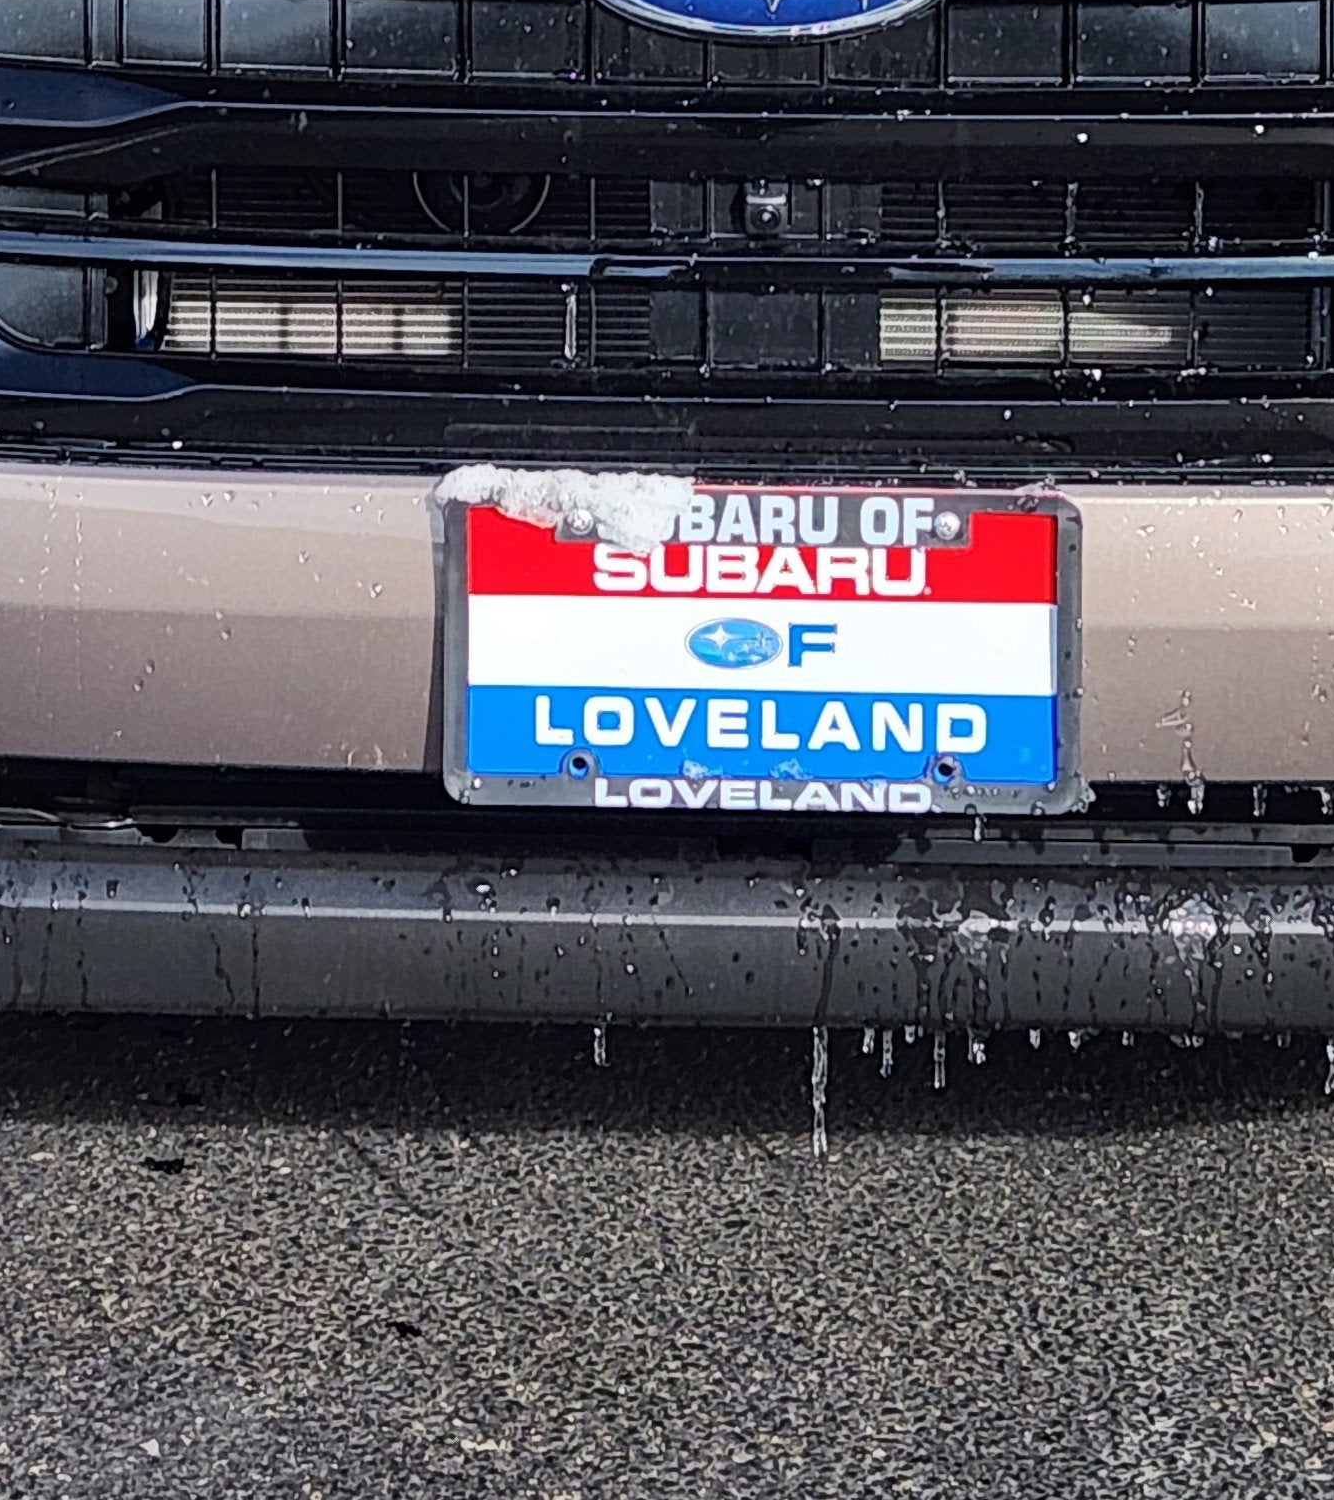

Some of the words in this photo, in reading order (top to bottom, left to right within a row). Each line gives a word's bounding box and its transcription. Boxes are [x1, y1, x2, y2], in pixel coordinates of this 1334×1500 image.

[596, 494, 839, 544] BARU
[860, 496, 935, 546] OF
[593, 543, 926, 596] SUBARU
[535, 695, 987, 753] LOVELAND
[595, 777, 934, 813] LOVELAND
